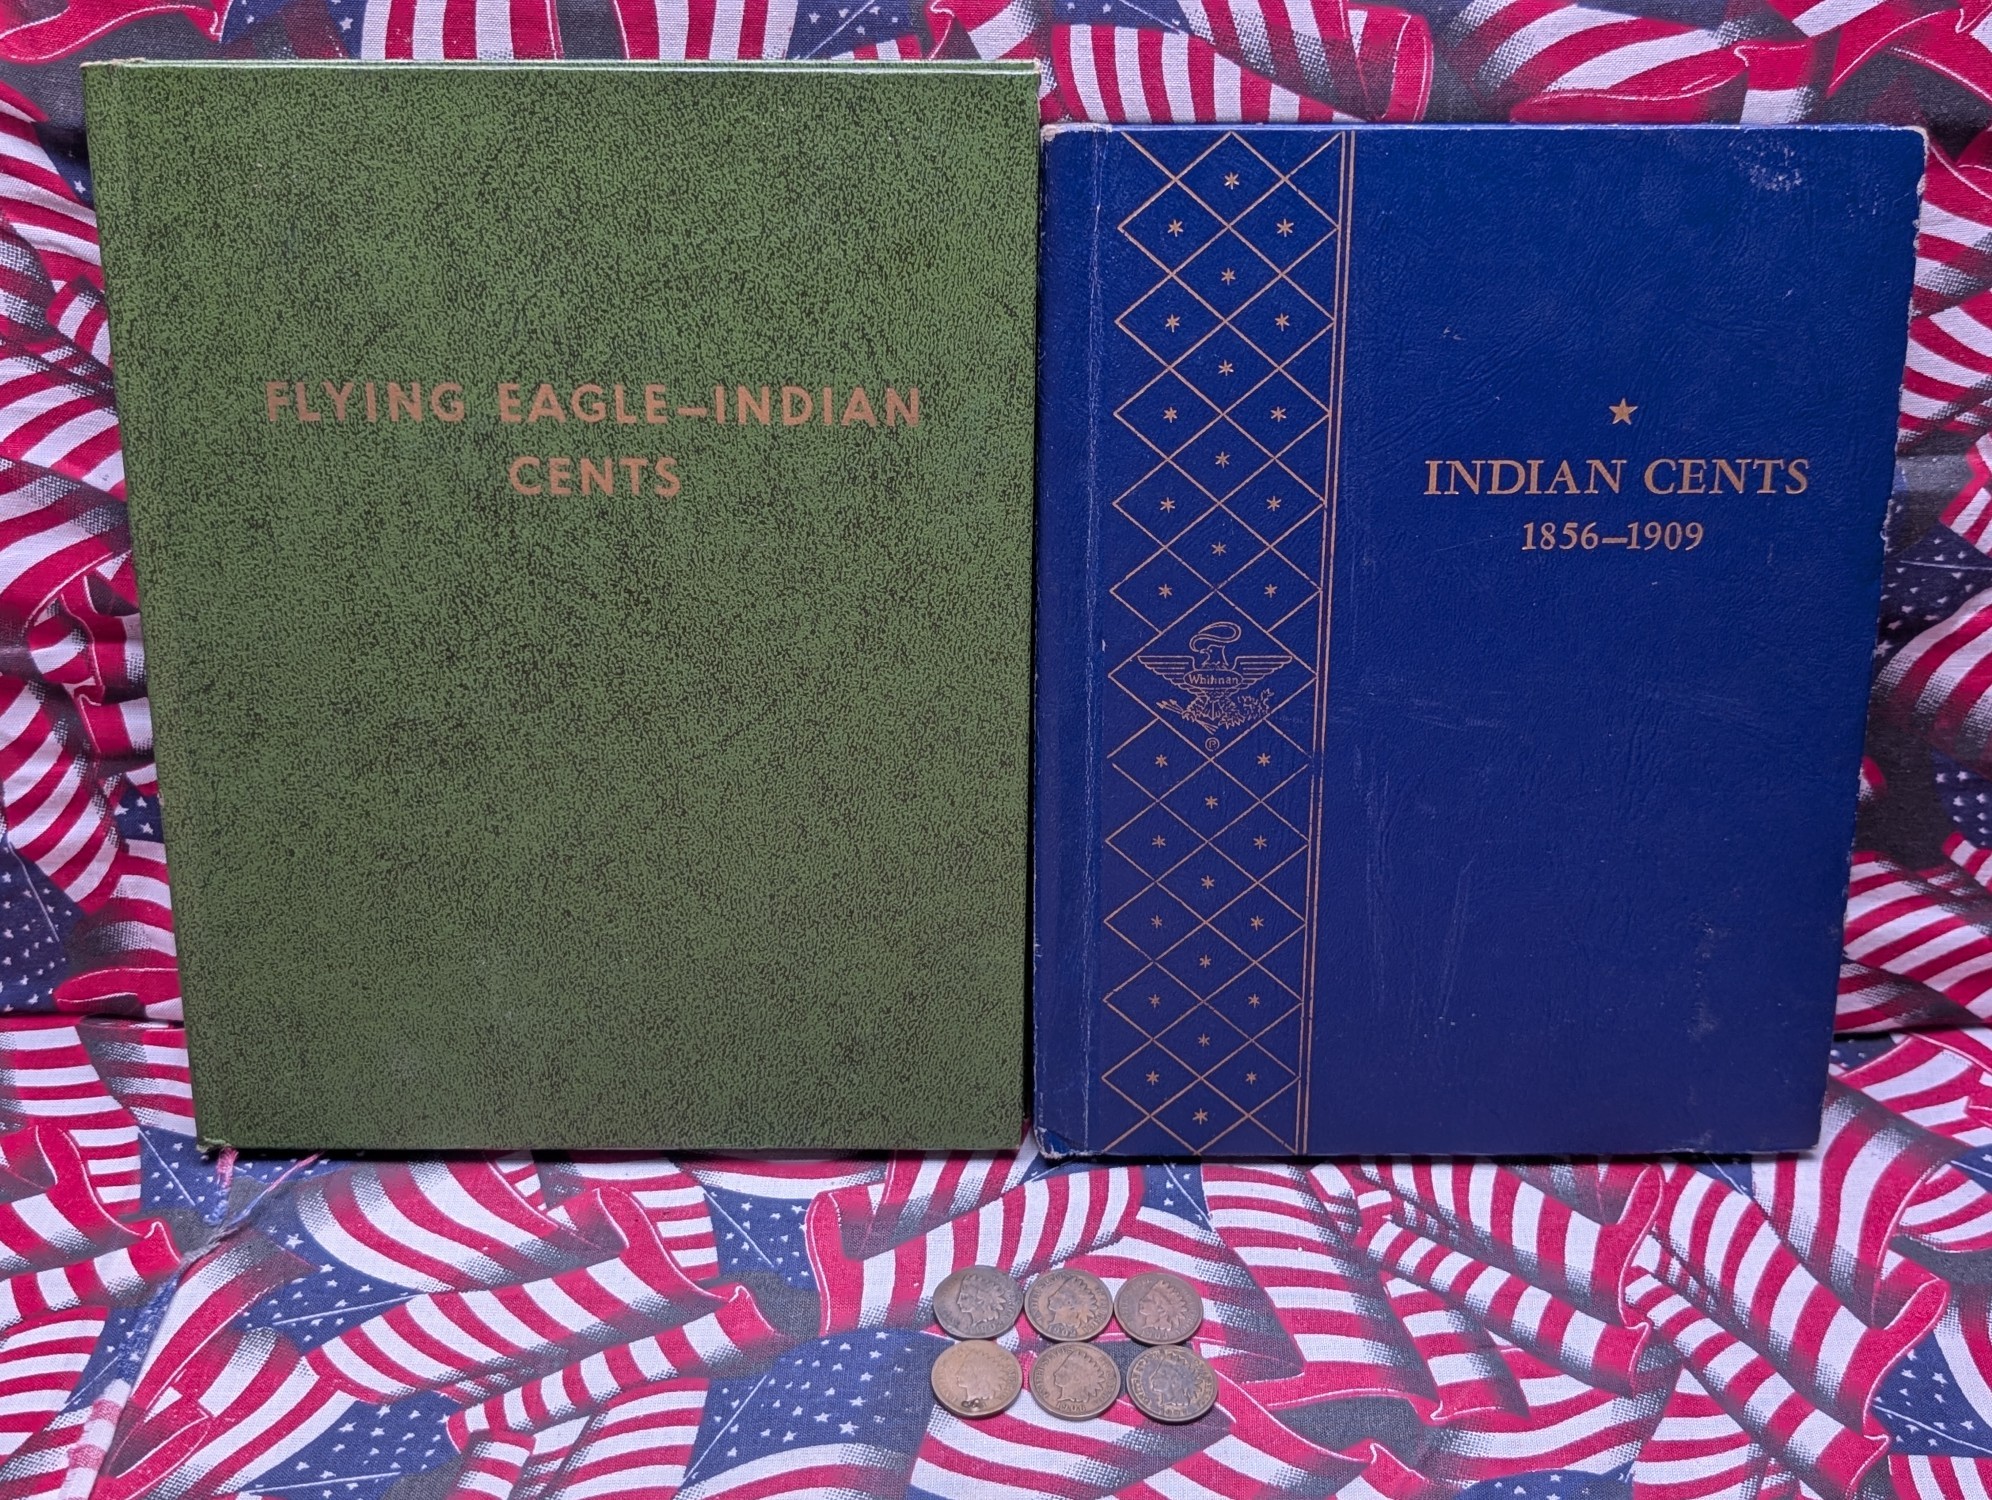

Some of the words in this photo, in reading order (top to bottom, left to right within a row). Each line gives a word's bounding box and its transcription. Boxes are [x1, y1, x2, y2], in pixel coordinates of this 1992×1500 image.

[266, 381, 464, 422] FLYING
[508, 456, 681, 497] CENTS
[1425, 460, 1625, 494] INDIAN
[1644, 459, 1807, 494] CENTS
[1188, 673, 1239, 685] Whitman
